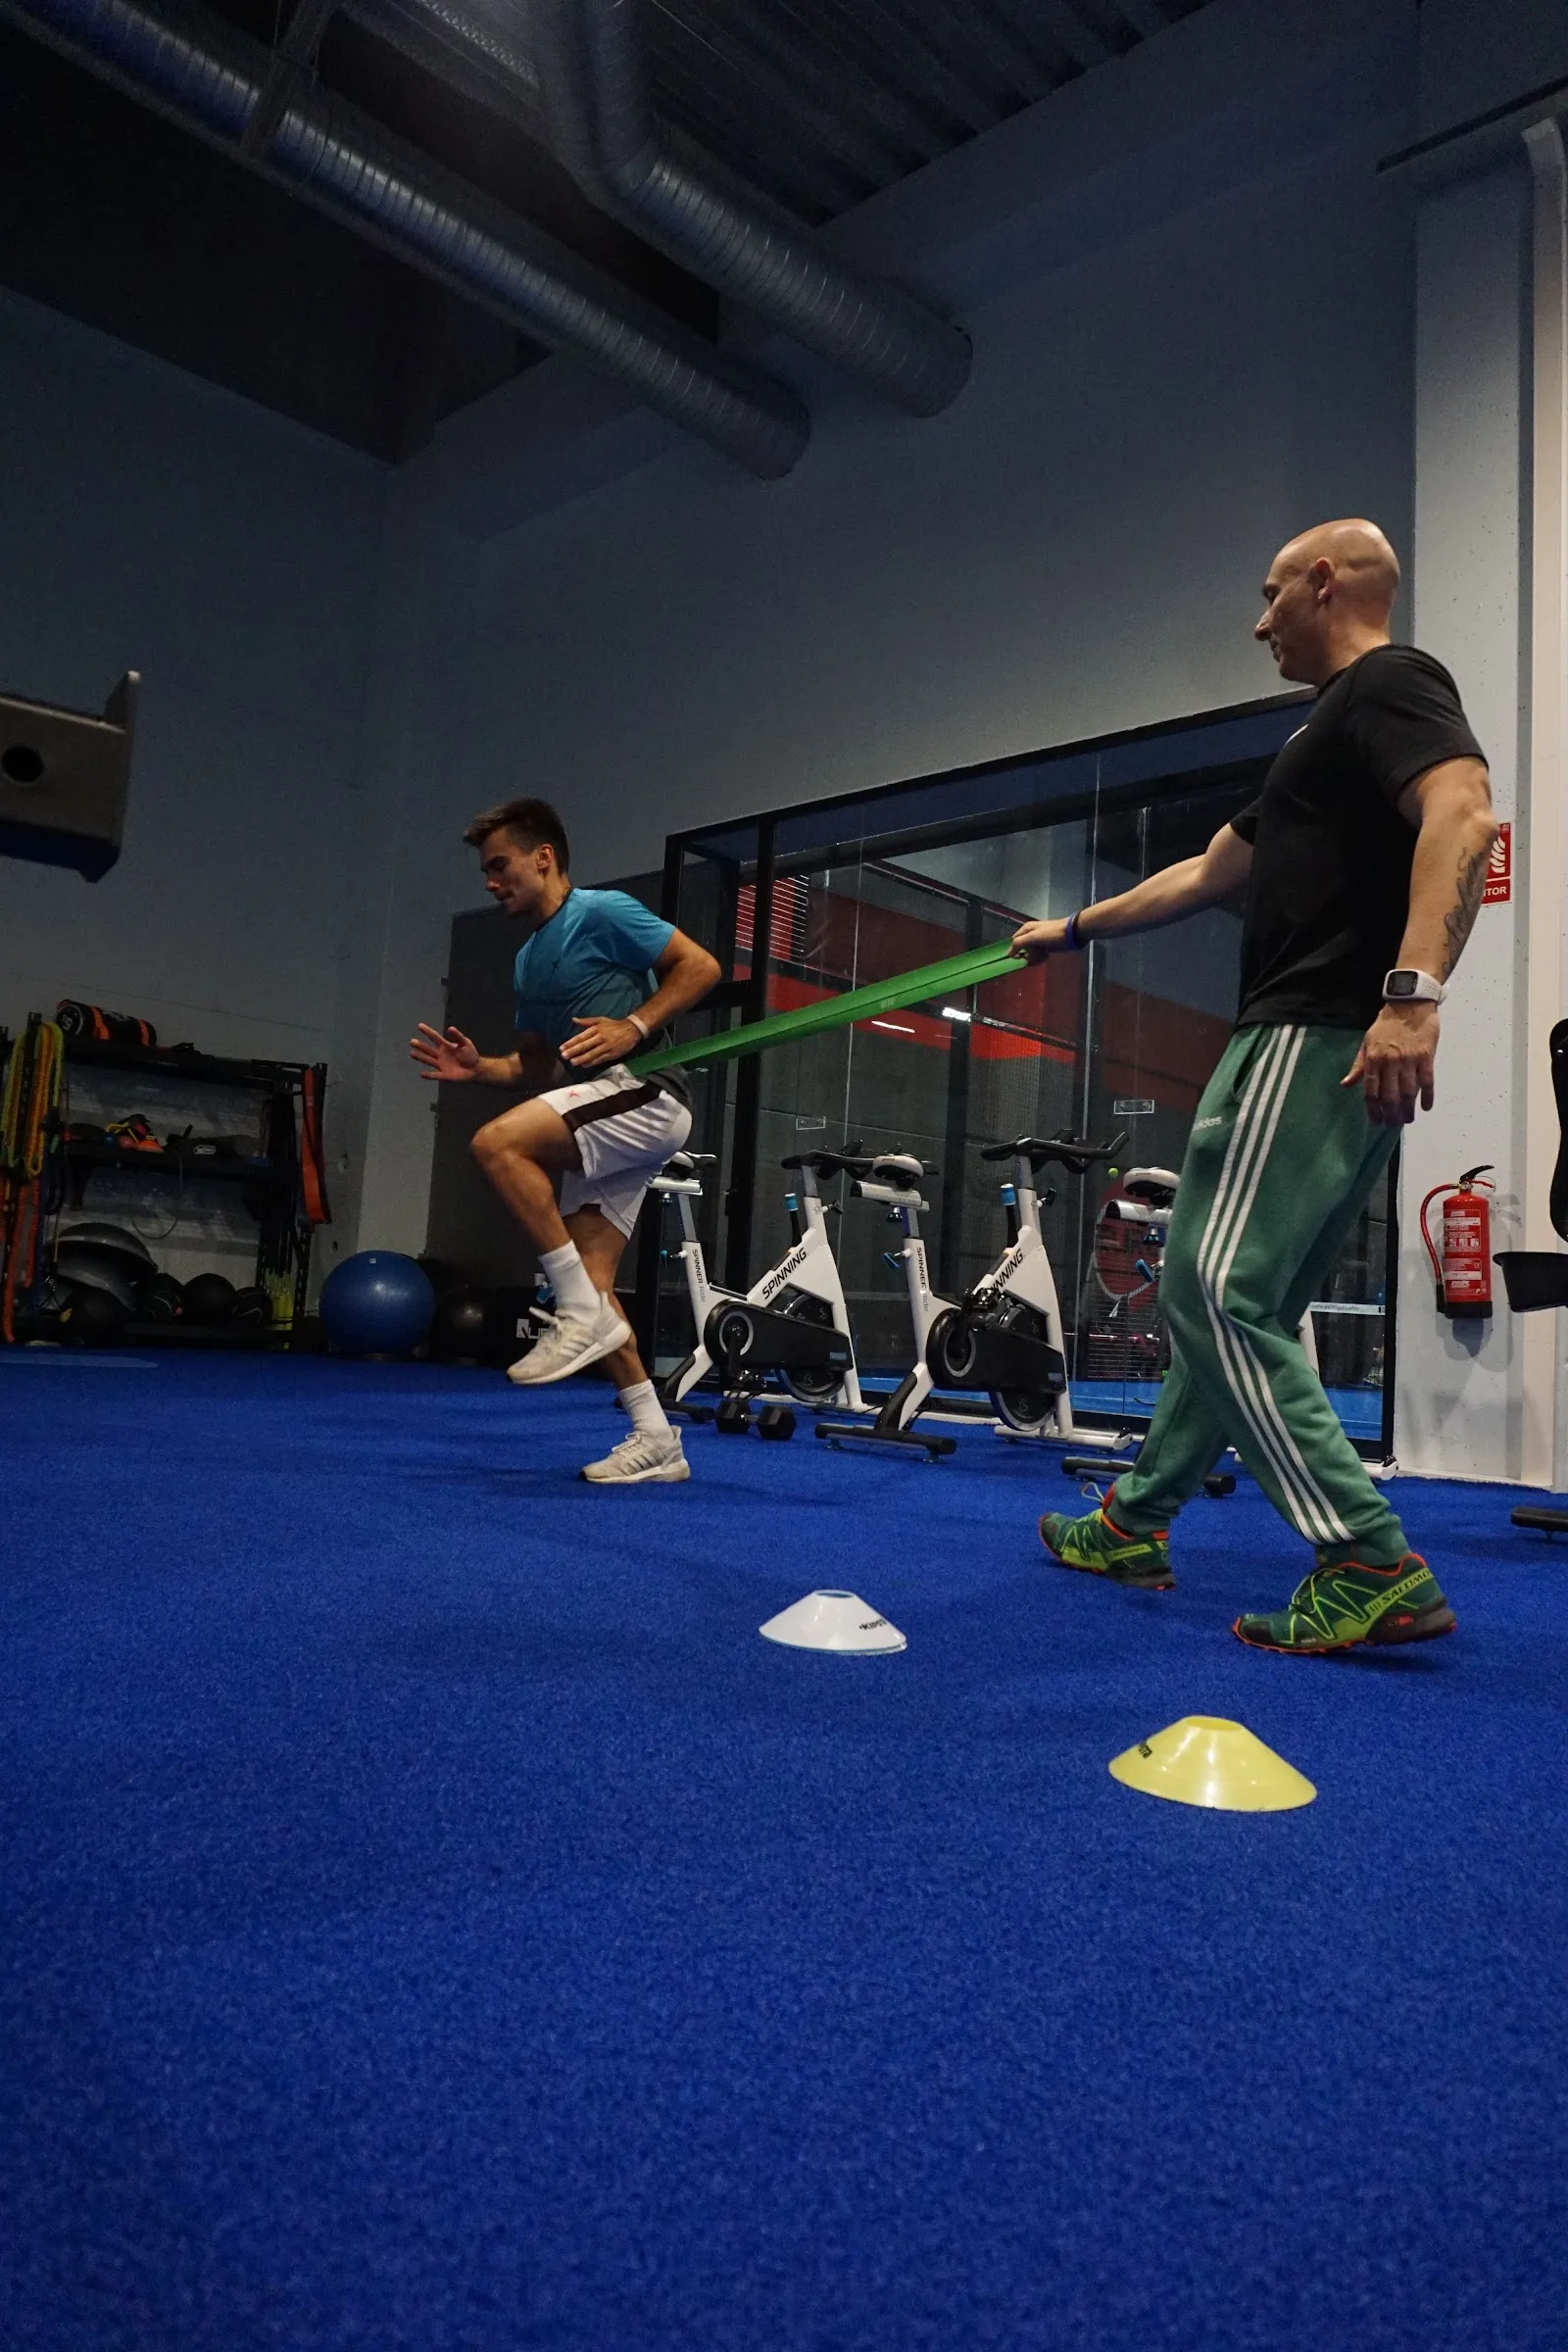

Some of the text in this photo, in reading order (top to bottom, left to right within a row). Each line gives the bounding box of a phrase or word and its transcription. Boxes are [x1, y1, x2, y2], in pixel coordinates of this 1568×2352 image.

[692, 1249, 704, 1284] SPINNER
[761, 1247, 807, 1300] SPINNING
[916, 1247, 927, 1291] SPINNER
[1382, 1570, 1430, 1605] SALOMO
